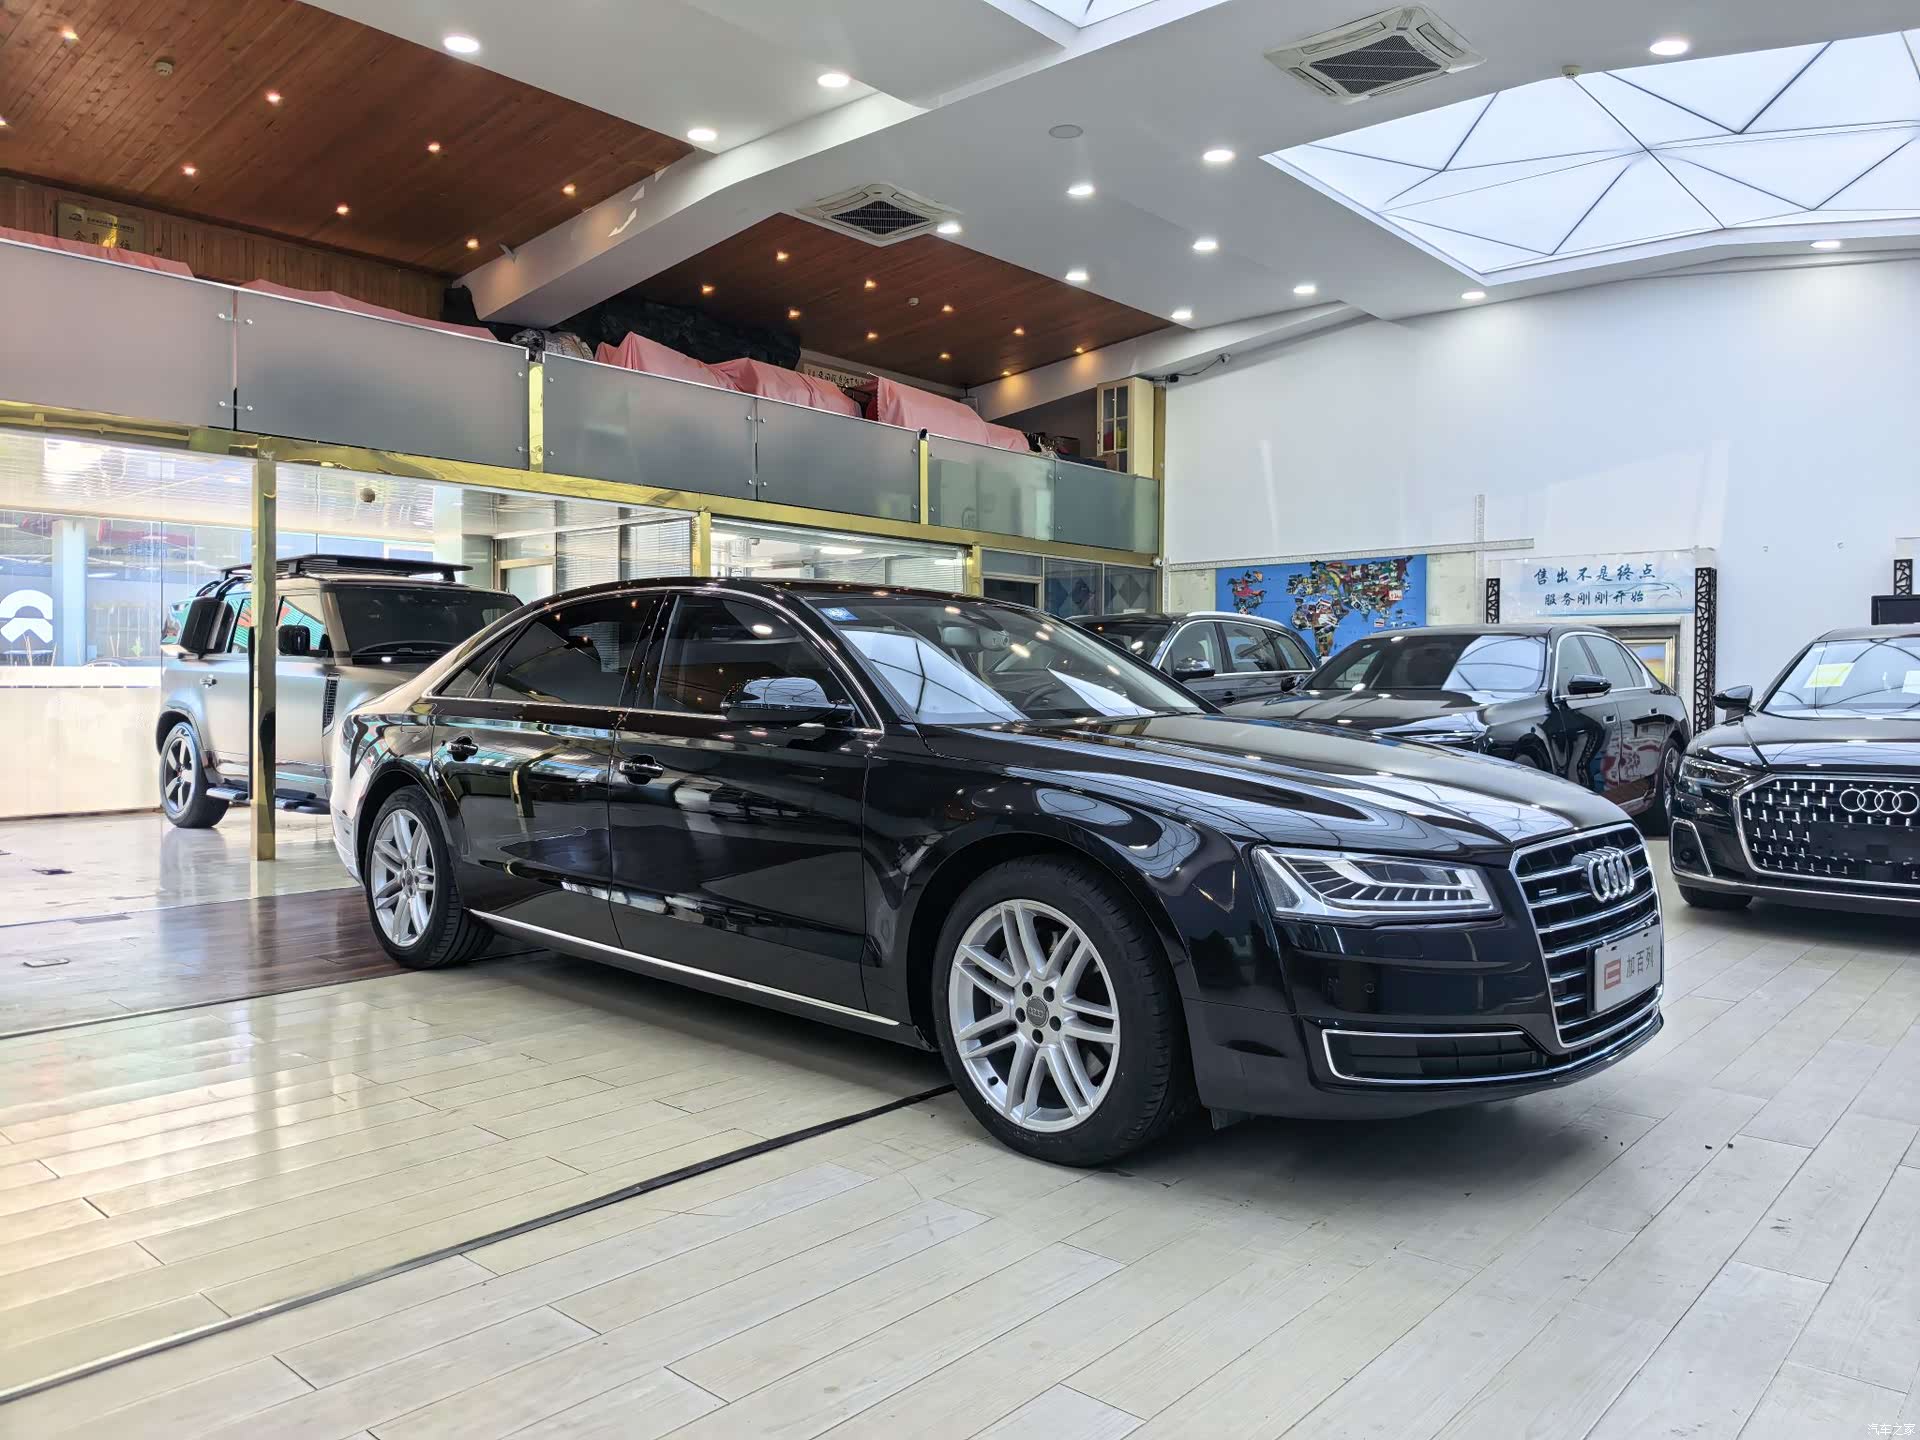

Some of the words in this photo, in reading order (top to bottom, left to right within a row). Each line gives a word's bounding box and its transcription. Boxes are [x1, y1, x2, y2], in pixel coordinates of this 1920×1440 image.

[1534, 563, 1656, 586] 售出不是终点
[1544, 590, 1645, 607] 服务刚刚开始
[1626, 945, 1654, 979] 加百列
